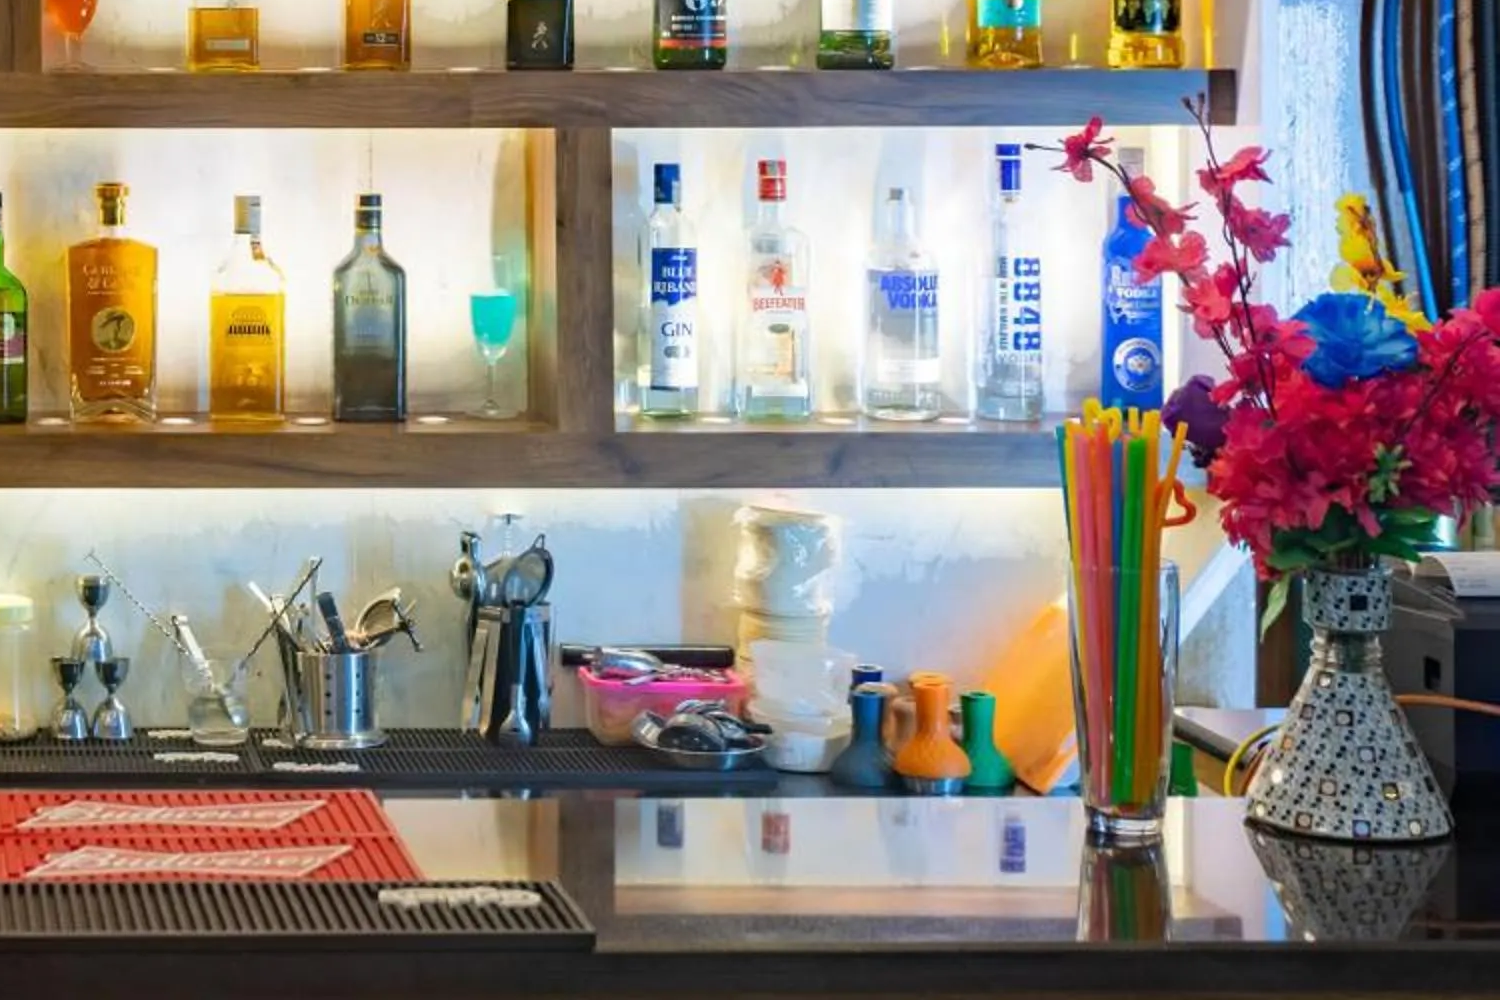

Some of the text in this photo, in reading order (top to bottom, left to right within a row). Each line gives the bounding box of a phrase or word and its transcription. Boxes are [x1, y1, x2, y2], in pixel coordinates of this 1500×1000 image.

[653, 281, 697, 293] RIBAN
[880, 275, 938, 291] ABSOLU
[1013, 257, 1041, 350] 8848
[661, 321, 692, 337] GIN
